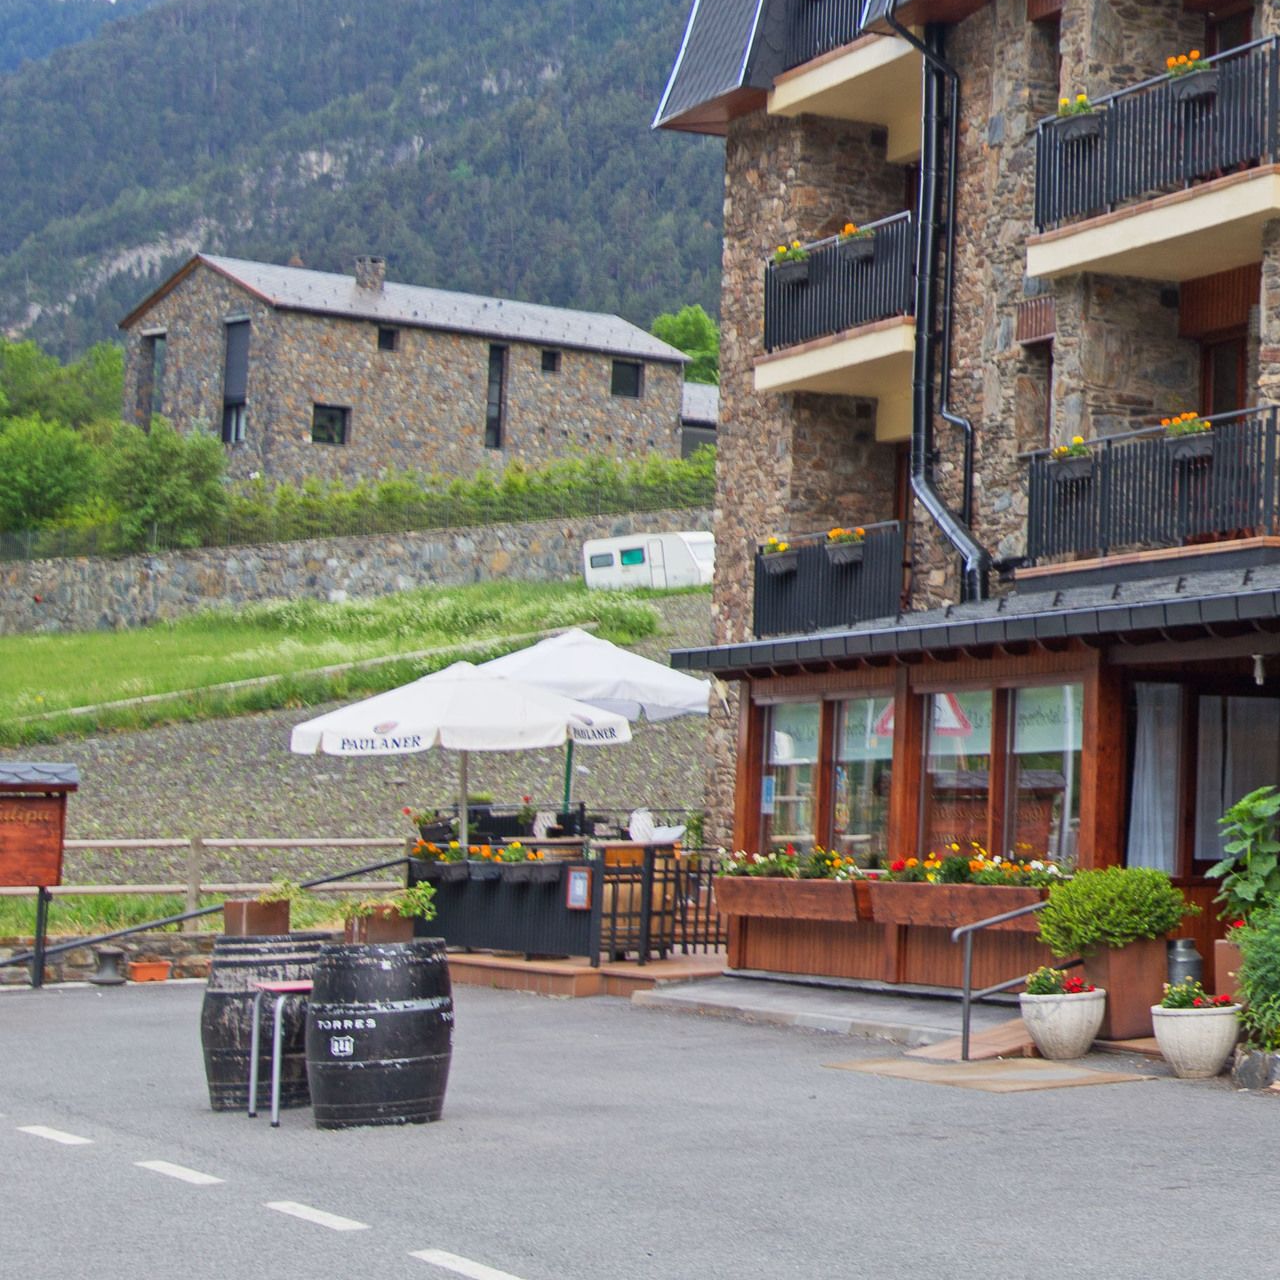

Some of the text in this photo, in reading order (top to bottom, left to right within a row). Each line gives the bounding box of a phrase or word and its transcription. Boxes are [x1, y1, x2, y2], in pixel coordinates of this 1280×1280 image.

[573, 727, 617, 740] PAULANER
[341, 735, 421, 751] PAULANER
[317, 1018, 376, 1030] TORRES
